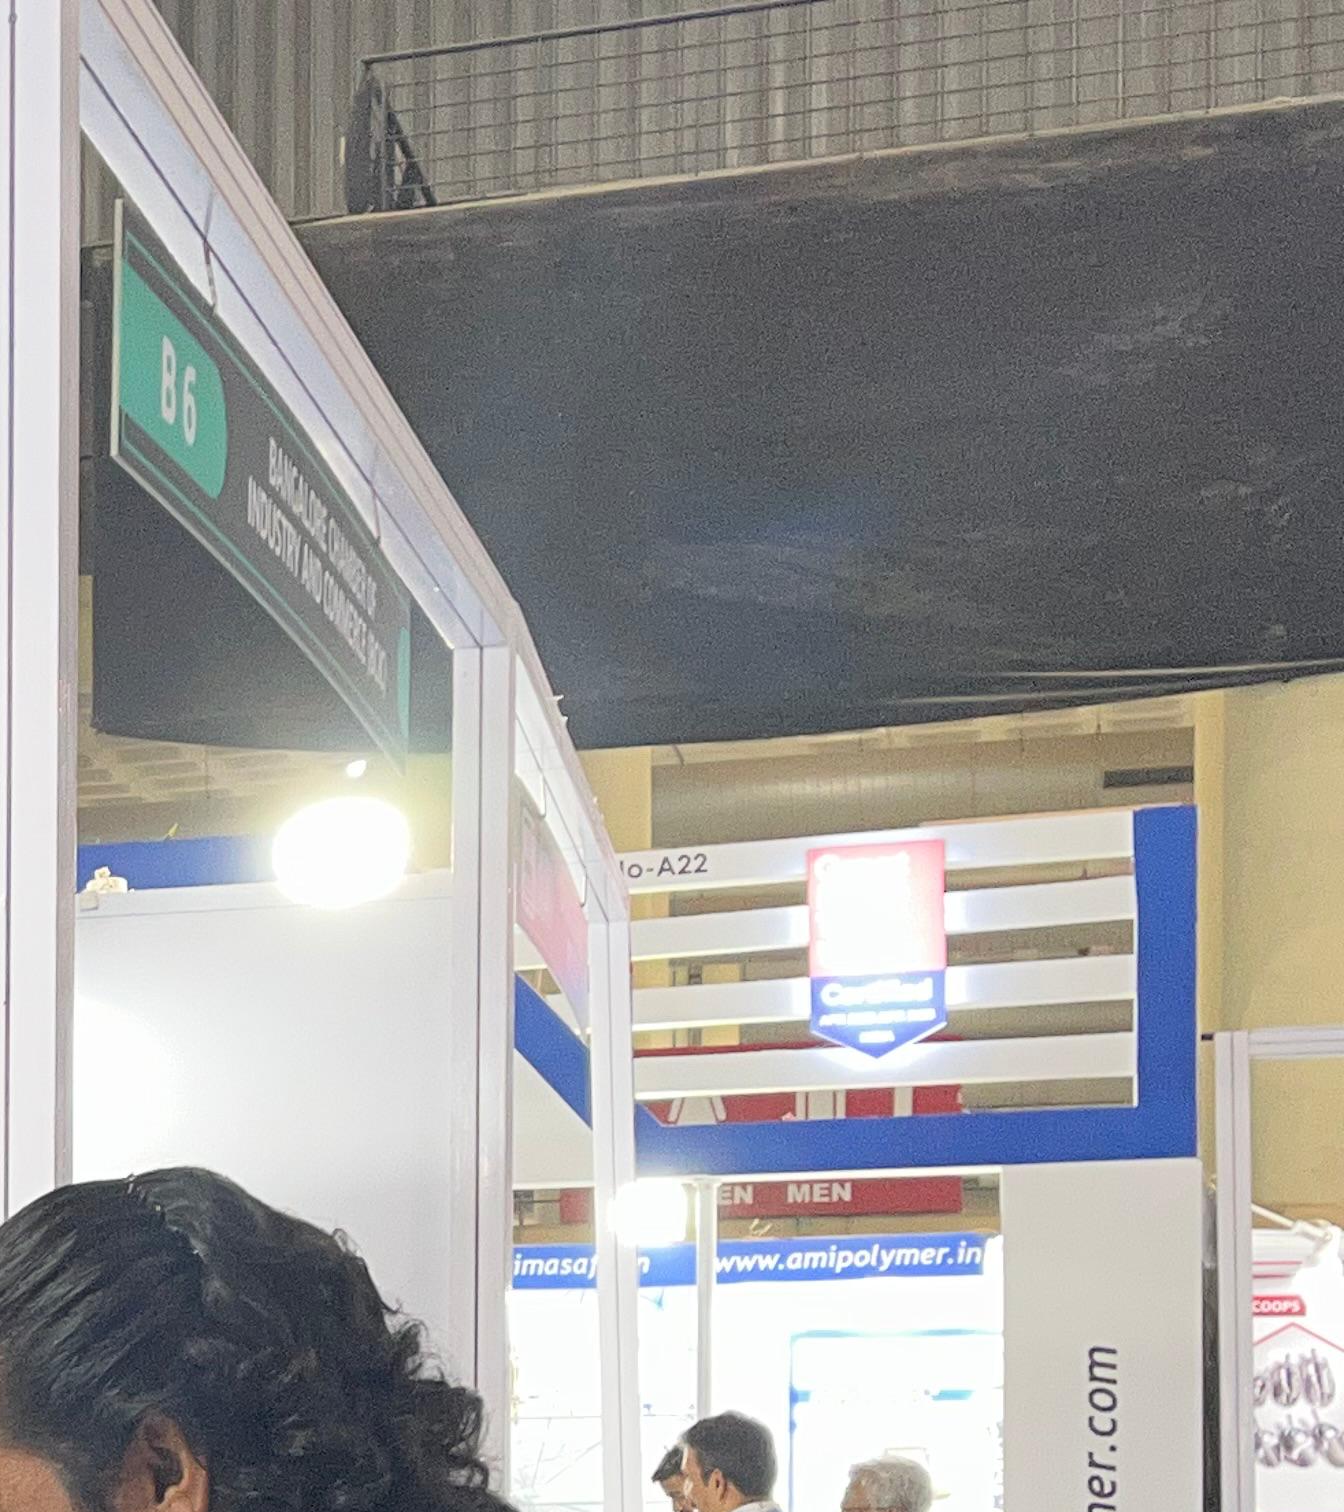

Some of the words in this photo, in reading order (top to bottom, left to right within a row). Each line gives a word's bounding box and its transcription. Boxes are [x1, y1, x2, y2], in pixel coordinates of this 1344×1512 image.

[247, 474, 302, 578] INDUSTRY
[787, 1182, 853, 1204] MEN
[715, 1240, 983, 1274] www.amipolymer.in
[1252, 1300, 1301, 1314] COOPS
